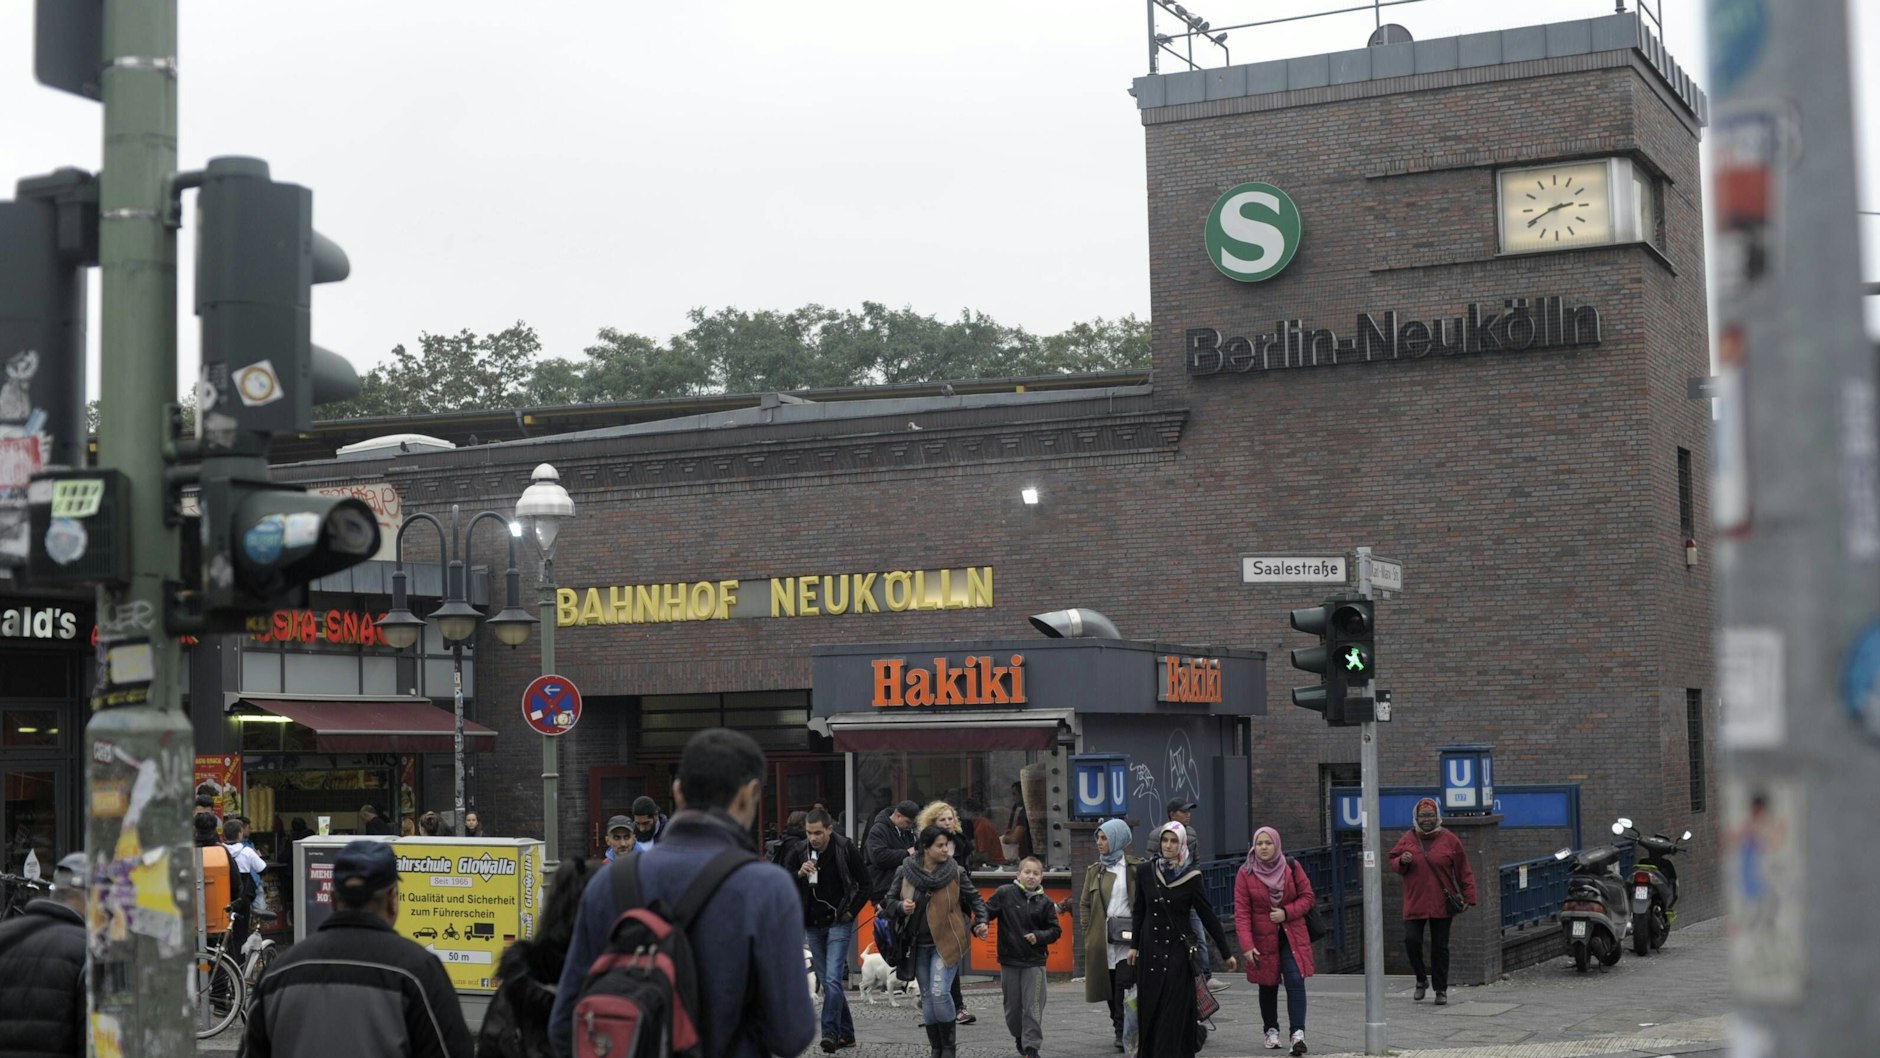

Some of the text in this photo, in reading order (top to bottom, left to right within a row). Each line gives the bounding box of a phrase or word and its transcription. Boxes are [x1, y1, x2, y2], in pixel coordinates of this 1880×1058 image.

[1219, 190, 1285, 274] S
[1186, 296, 1602, 376] Berlin-Neukölln
[1253, 560, 1338, 578] Saalestraße
[557, 566, 994, 627] BAHNHOF NEUKÖLLN
[1, 606, 76, 639] ald's
[255, 609, 317, 645] SIA
[871, 654, 1027, 707] Hakiki
[1165, 656, 1222, 704] Hakiki
[1449, 759, 1471, 787] U
[1483, 759, 1490, 786] U
[1078, 771, 1105, 806] U
[1112, 771, 1124, 806] U
[1342, 797, 1362, 826] U
[396, 855, 516, 875] ahrschule Glowalla
[434, 877, 469, 886] Seit 1965
[408, 892, 444, 903] Qualität
[447, 893, 465, 904] und
[467, 894, 515, 906] Sicherheit
[410, 908, 495, 919] zum Führerschein
[448, 952, 459, 961] 50
